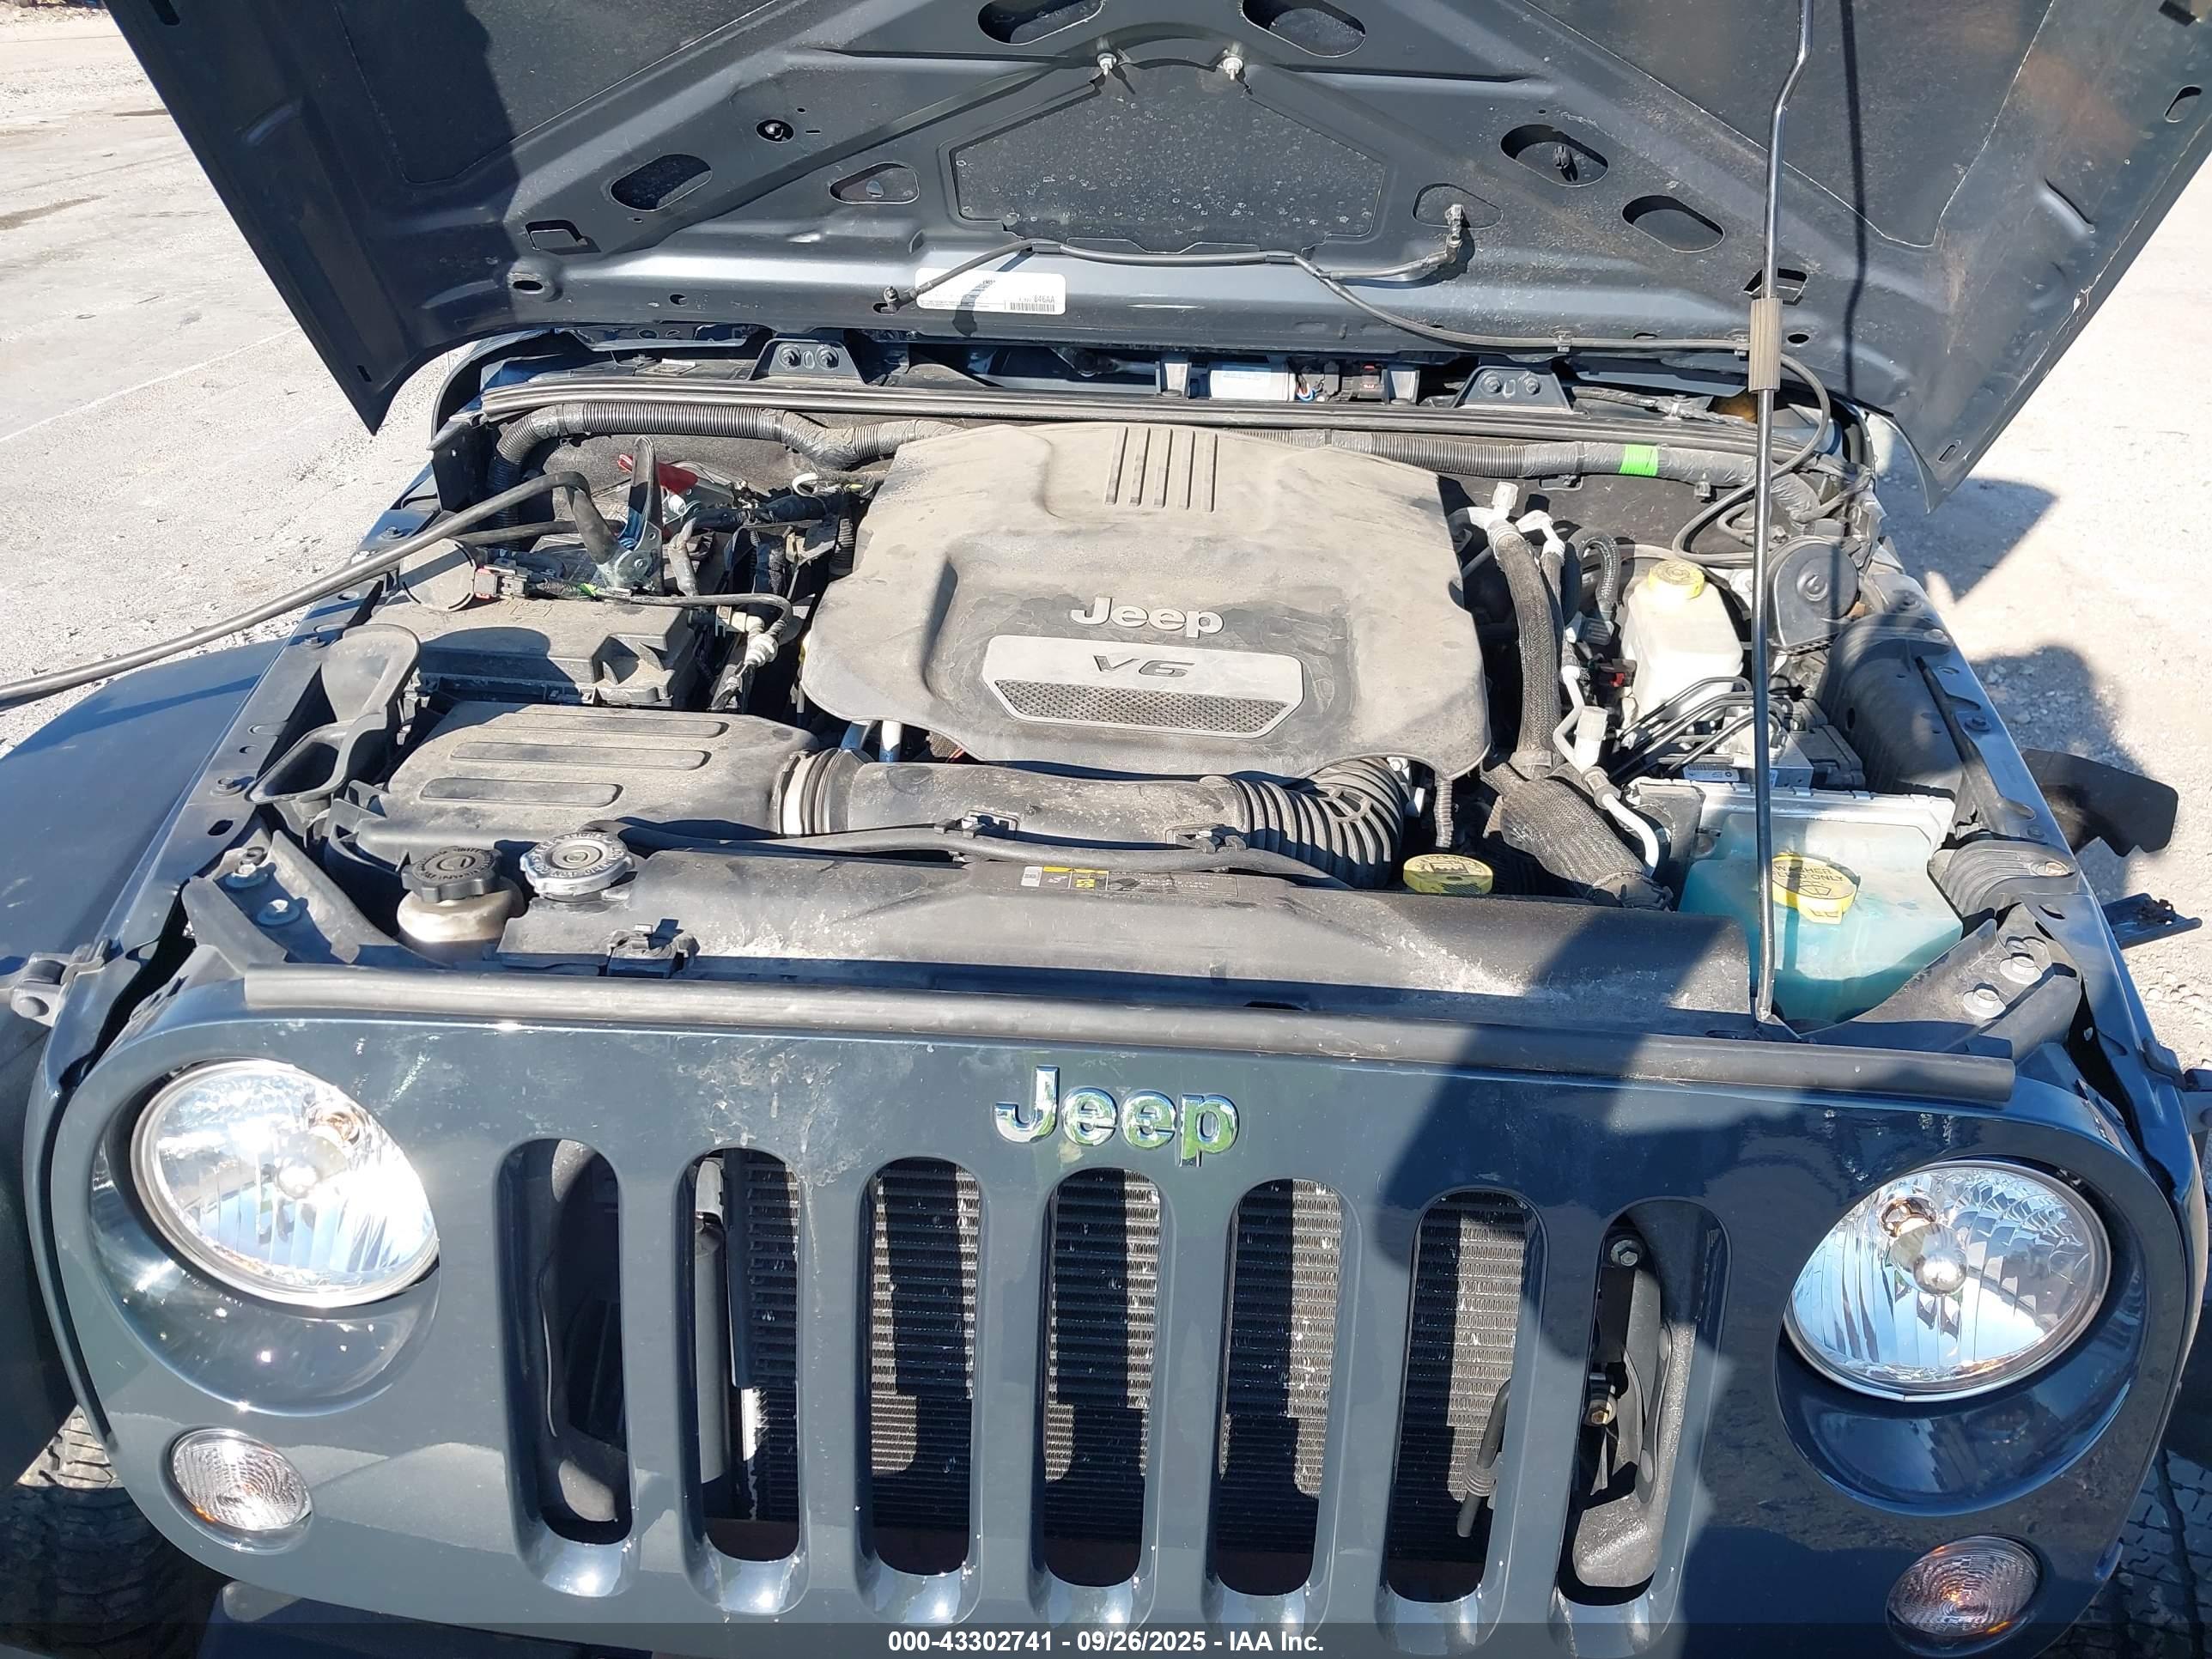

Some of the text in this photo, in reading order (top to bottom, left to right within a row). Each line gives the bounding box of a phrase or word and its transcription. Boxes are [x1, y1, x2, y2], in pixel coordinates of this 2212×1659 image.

[1071, 597, 1224, 639] Jeep
[1093, 655, 1195, 678] V6
[994, 1065, 1239, 1167] Jeep
